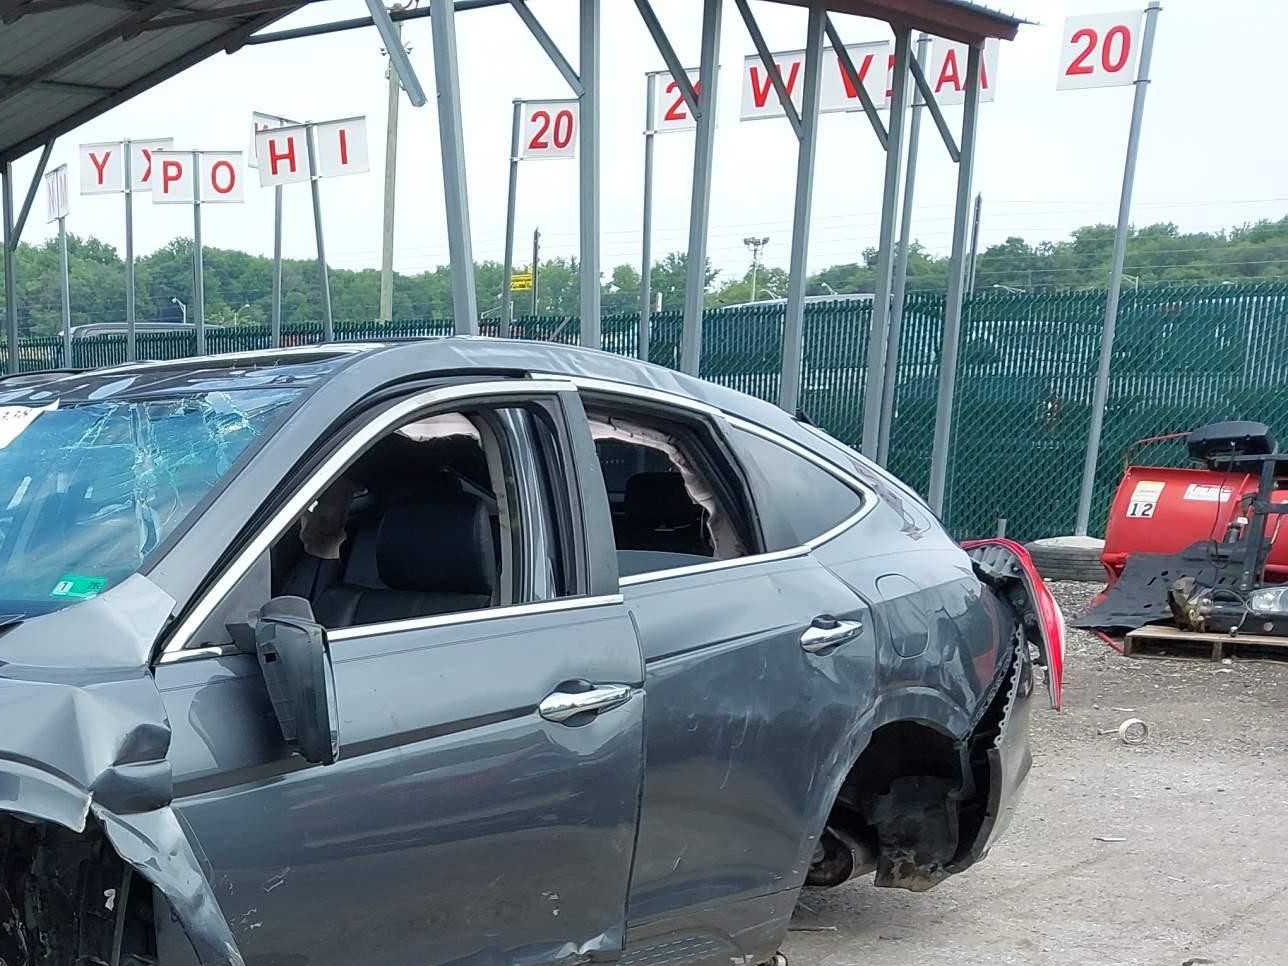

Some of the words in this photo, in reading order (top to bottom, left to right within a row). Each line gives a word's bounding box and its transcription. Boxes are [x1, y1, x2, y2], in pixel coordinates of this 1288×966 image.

[1066, 25, 1131, 76] 20
[749, 62, 800, 108] W
[528, 110, 574, 150] 20
[89, 151, 112, 185] Y
[268, 137, 297, 175] H
[339, 130, 348, 164] I
[162, 160, 183, 194] P
[211, 160, 236, 194] O
[1129, 502, 1153, 517] 12
